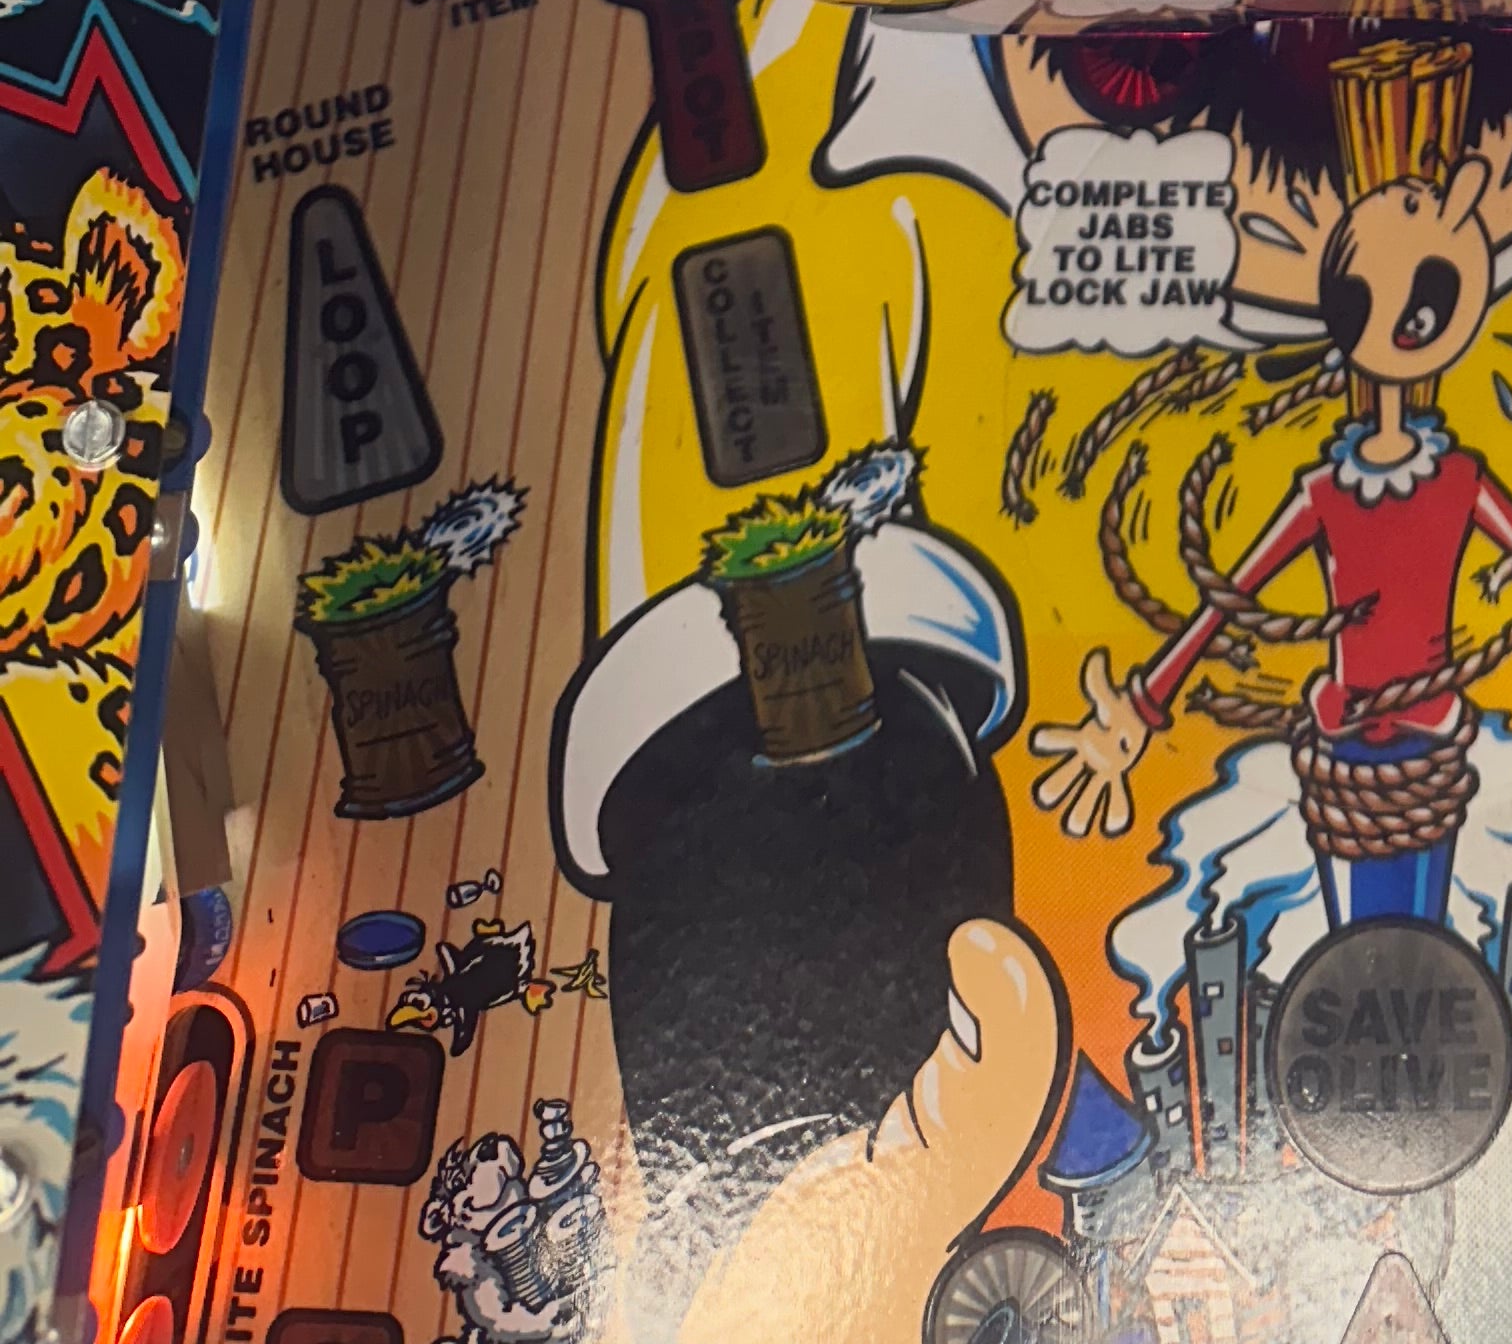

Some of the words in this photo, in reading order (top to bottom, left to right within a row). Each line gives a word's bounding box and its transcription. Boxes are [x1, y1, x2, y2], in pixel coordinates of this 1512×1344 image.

[245, 82, 390, 148] ROUND
[253, 117, 395, 184] HOUSE
[1028, 179, 1227, 207] COMPLETE
[1078, 212, 1174, 240] JABS
[1053, 245, 1102, 272] TO
[1115, 245, 1196, 272] LITE
[1026, 278, 1127, 306] LOCK
[1139, 278, 1219, 306] JAW
[316, 237, 383, 466] LOOP
[702, 257, 758, 463] COLLECT
[751, 288, 790, 406] ITEM
[1300, 986, 1478, 1048] SAVE
[330, 1059, 411, 1151] P
[1285, 1052, 1494, 1114] OLIVE
[242, 1039, 301, 1247] SPINACH
[222, 1265, 263, 1344] ITE
